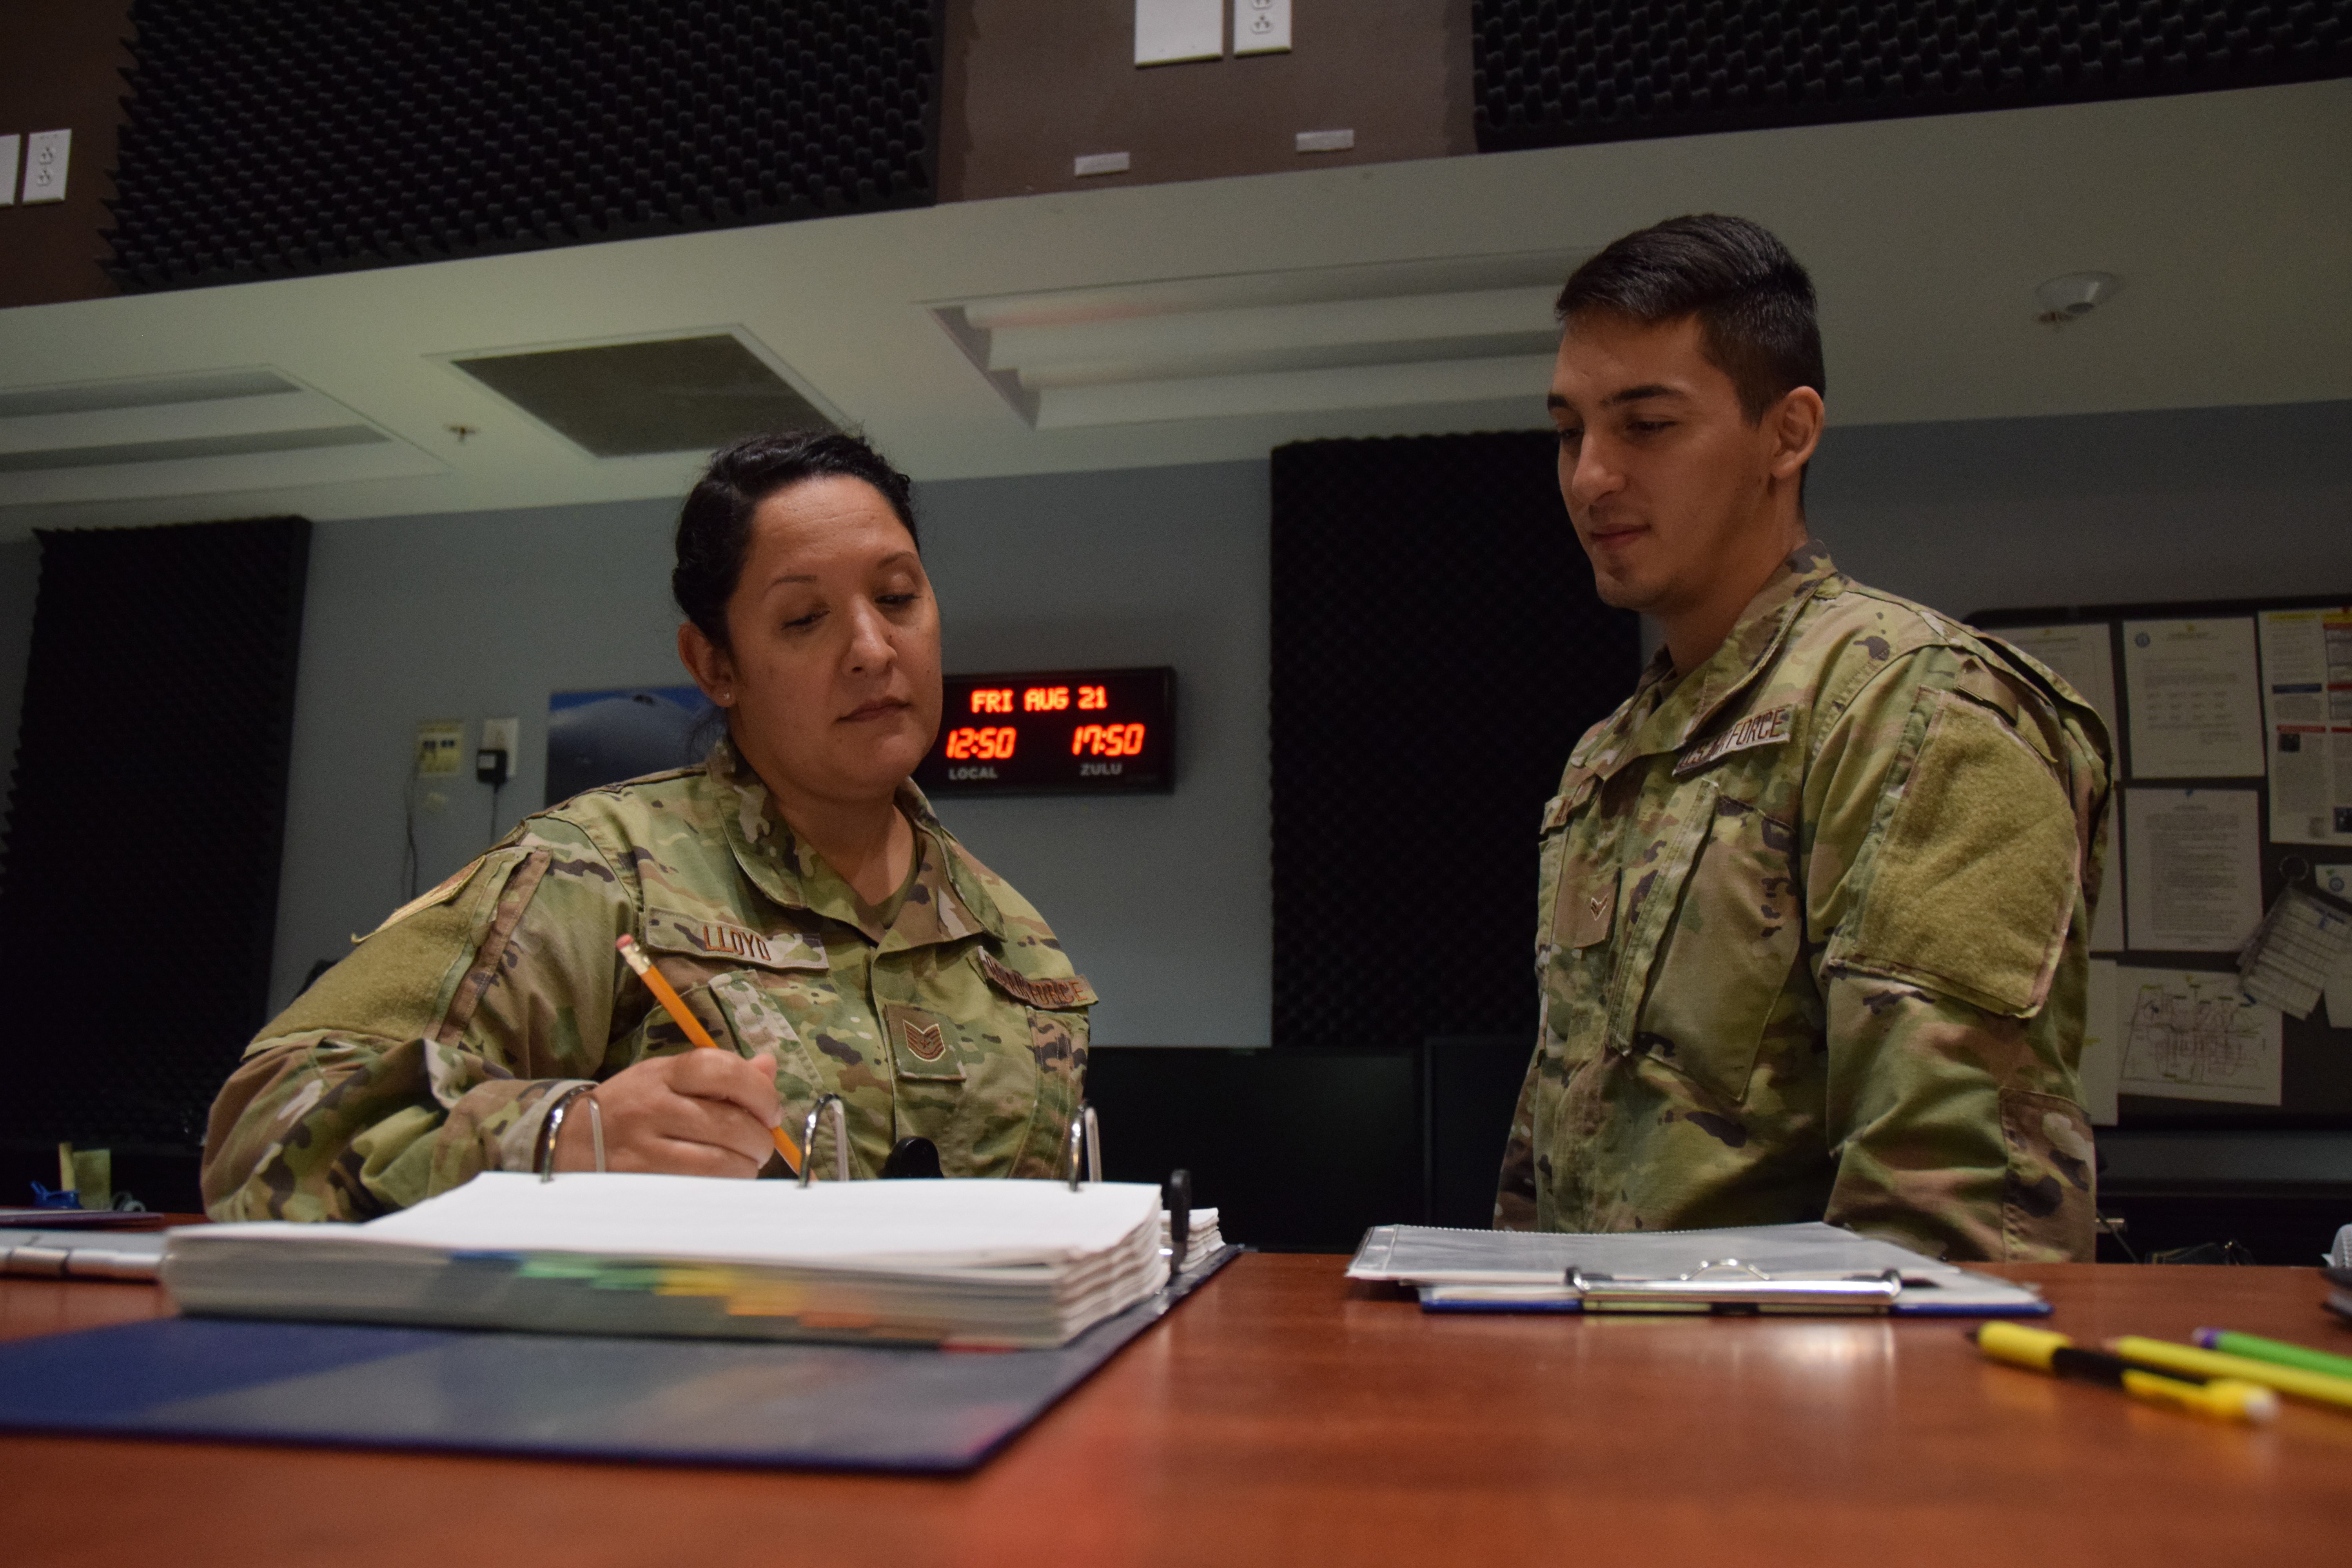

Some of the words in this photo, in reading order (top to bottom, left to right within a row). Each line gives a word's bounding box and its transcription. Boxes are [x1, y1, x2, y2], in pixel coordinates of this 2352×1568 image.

[971, 689, 1014, 713] FRI
[1024, 686, 1069, 711] AUG
[1078, 686, 1107, 709] 21
[946, 727, 1016, 759] 12:50
[1072, 723, 1145, 756] 17:50
[1726, 708, 1785, 749] FORCE
[948, 767, 998, 780] LOCAL
[1080, 762, 1123, 776] ZULU
[703, 925, 771, 960] LLOYD
[1027, 980, 1088, 1005] FORCE
